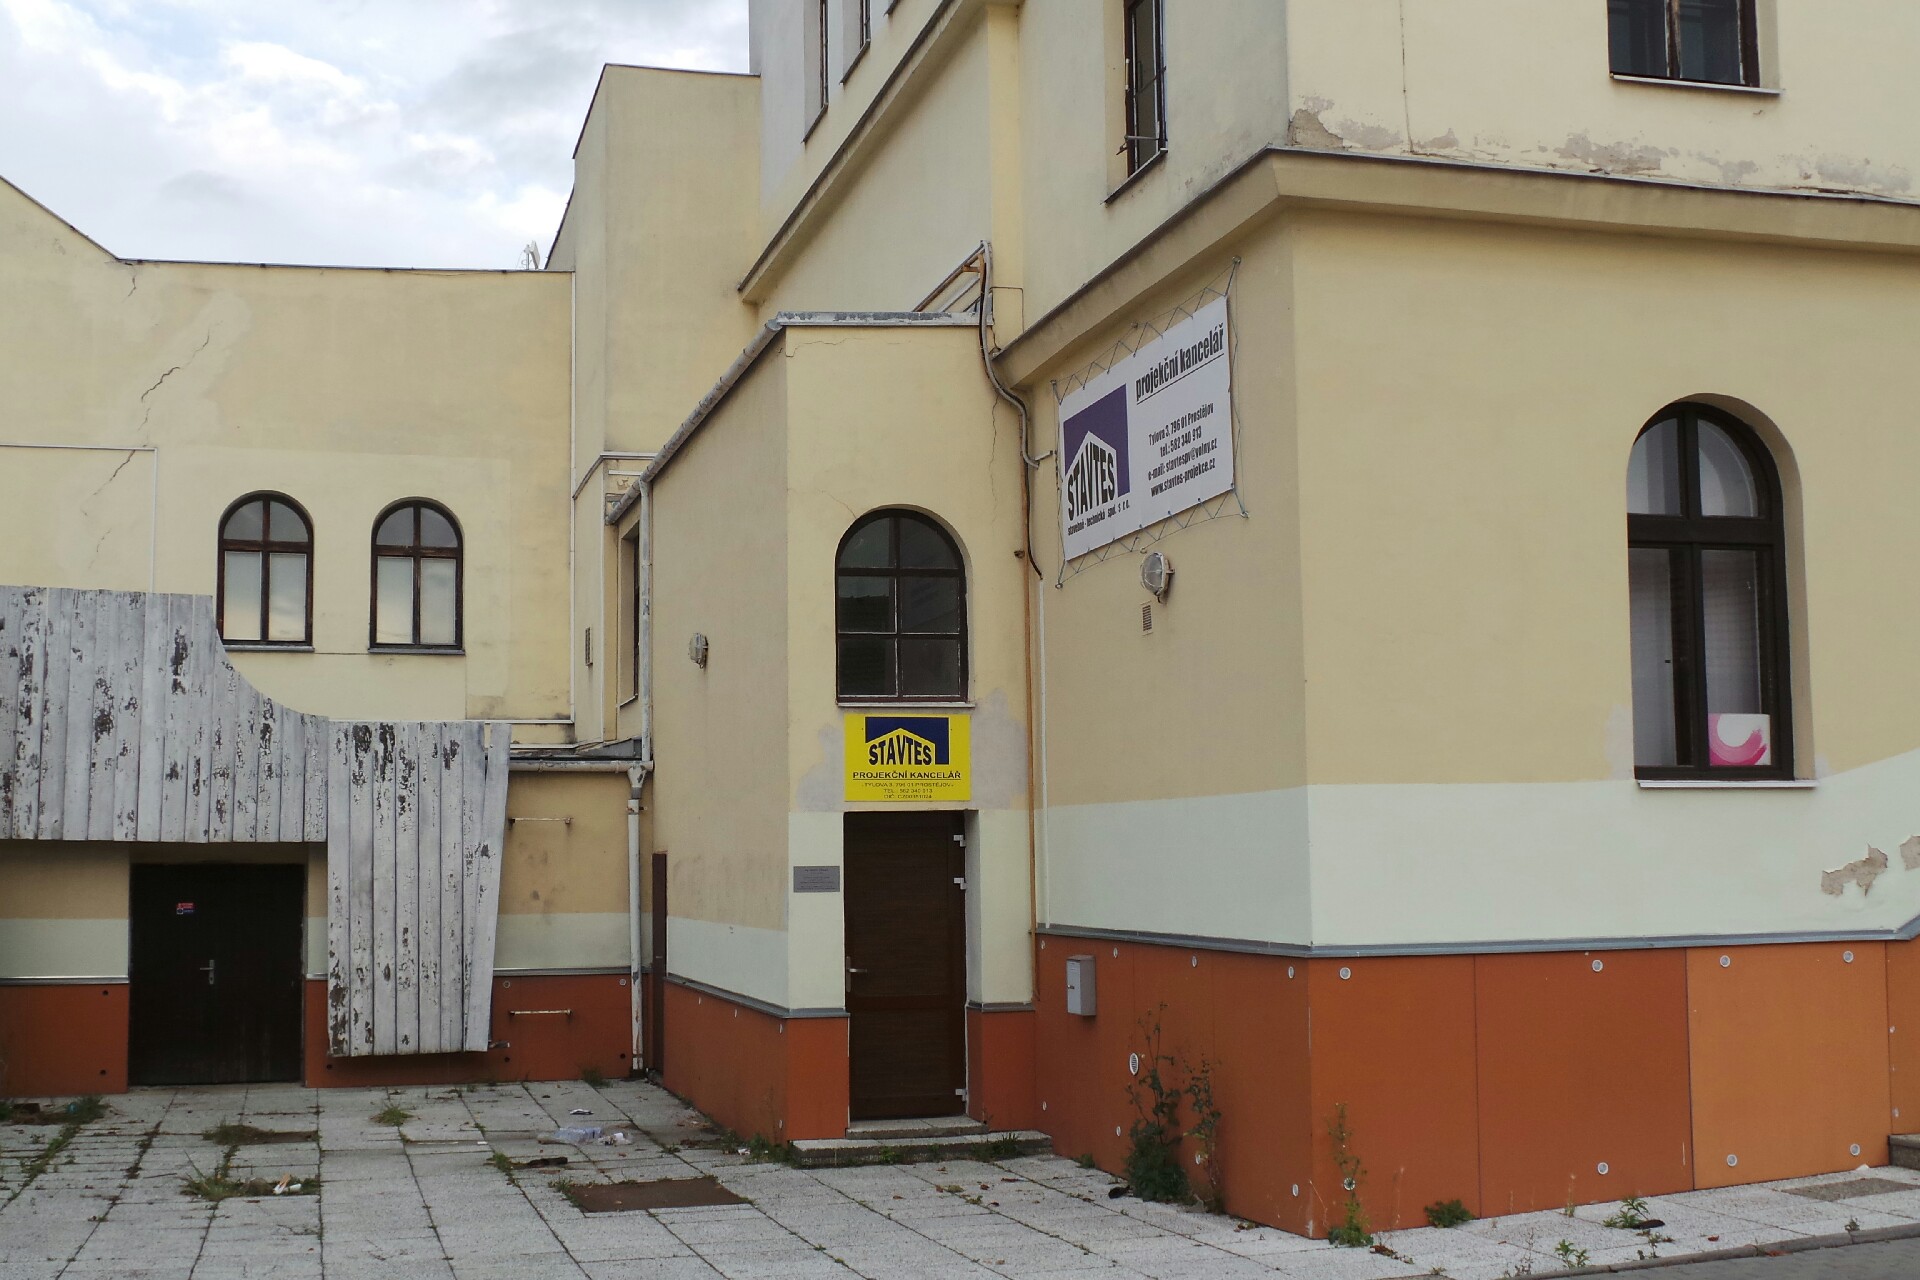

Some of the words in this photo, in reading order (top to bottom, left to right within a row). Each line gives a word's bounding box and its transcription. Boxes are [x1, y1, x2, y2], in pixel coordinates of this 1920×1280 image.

[1136, 350, 1178, 402] projekční
[1180, 322, 1223, 374] kancelář
[1171, 419, 1180, 434] 796
[1188, 403, 1213, 426] Prostějov
[1067, 441, 1115, 521] STAVTES
[868, 734, 932, 765] STAVTES
[853, 770, 907, 779] PROJEKČNÍ
[910, 771, 961, 779] KANCELÁŘ
